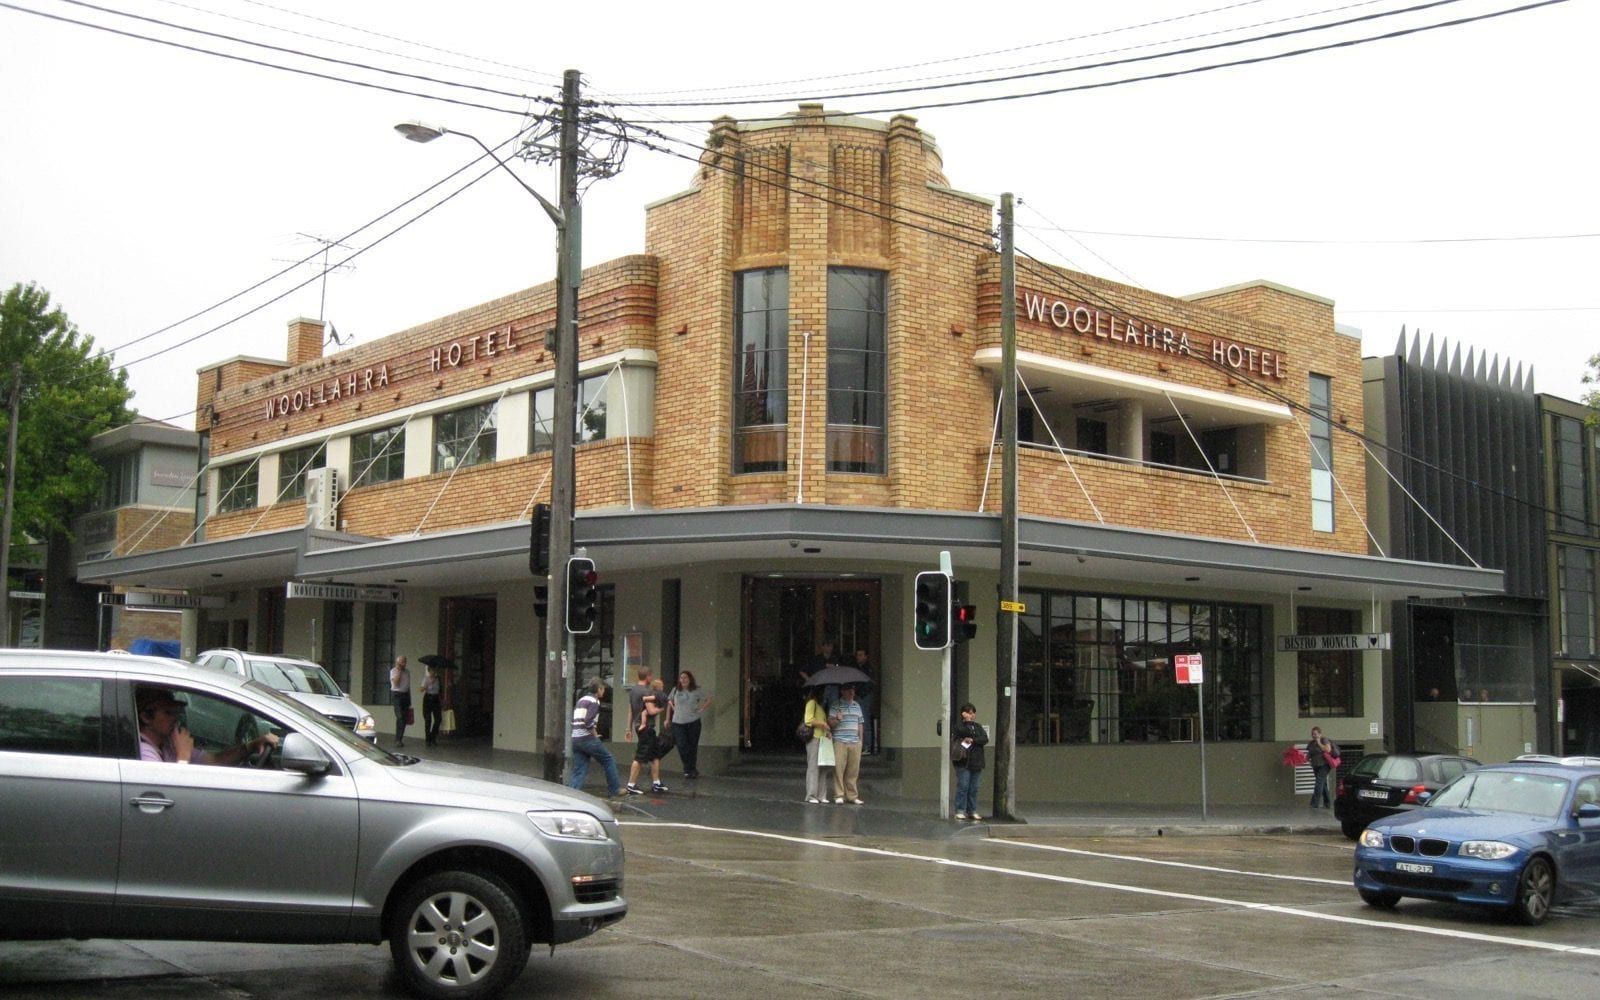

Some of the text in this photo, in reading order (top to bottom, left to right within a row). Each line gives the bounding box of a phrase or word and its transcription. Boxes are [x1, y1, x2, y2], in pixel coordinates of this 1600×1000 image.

[265, 325, 517, 420] WOOLLAHRA HOTEL
[1024, 292, 1285, 379] WOOLLAHRA HOTEL
[1284, 635, 1359, 649] BISTRO MONCUR
